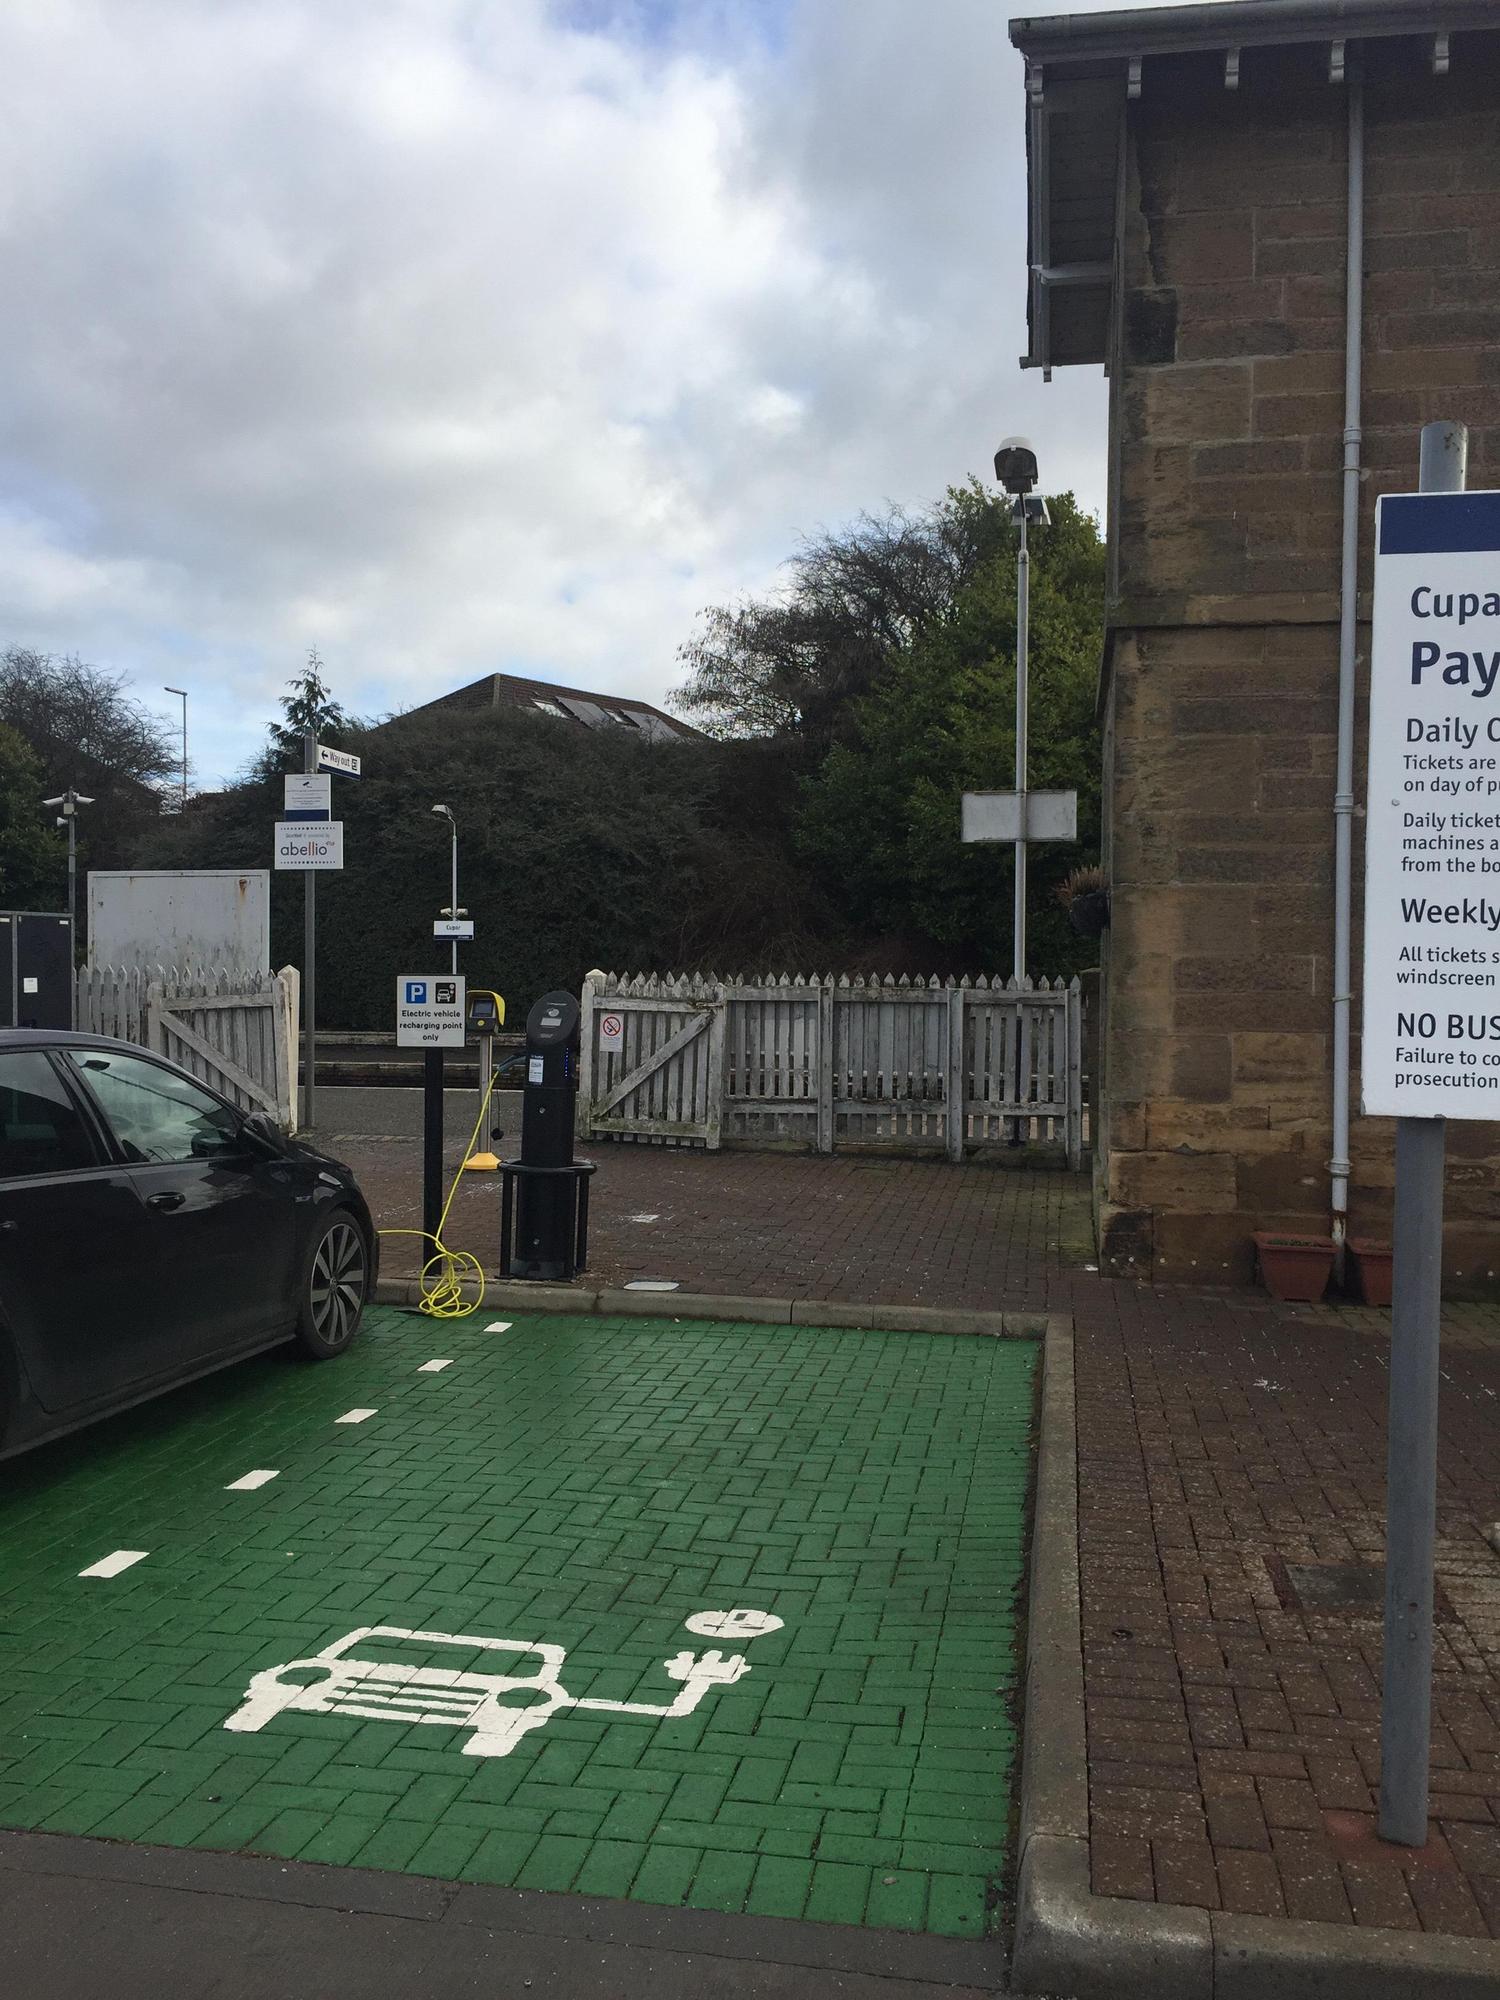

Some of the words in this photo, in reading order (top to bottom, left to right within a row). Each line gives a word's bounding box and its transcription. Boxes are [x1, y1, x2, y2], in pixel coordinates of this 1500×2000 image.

[1410, 586, 1500, 626] Cupa
[1411, 641, 1500, 698] Pay
[1406, 716, 1479, 750] Daily
[330, 751, 341, 766] Way
[341, 757, 350, 767] out
[1403, 754, 1464, 770] Tickets
[1468, 758, 1497, 770] are
[1403, 780, 1425, 792] on
[1430, 776, 1461, 796] day
[1465, 775, 1485, 792] of
[1403, 812, 1447, 832] Daily
[1450, 812, 1500, 828] ticket
[280, 841, 328, 856] abellio
[1402, 834, 1485, 851] machines
[1400, 856, 1441, 872] from
[1446, 856, 1476, 873] the
[1481, 856, 1500, 873] bo
[1400, 897, 1500, 932] Weekly
[1398, 945, 1423, 962] All
[1426, 946, 1487, 964] tickets
[1396, 968, 1495, 986] windscreen
[411, 984, 424, 1002] P
[401, 1010, 431, 1018] Electric
[433, 1010, 461, 1018] vehicle
[399, 1021, 440, 1030] recharging
[442, 1022, 462, 1030] point
[1397, 1012, 1437, 1039] NO
[1447, 1014, 1500, 1041] BUS
[422, 1033, 439, 1042] only
[1395, 1047, 1455, 1065] Failure
[1458, 1050, 1477, 1066] to
[1482, 1054, 1500, 1066] co
[1395, 1071, 1498, 1089] prosecution
